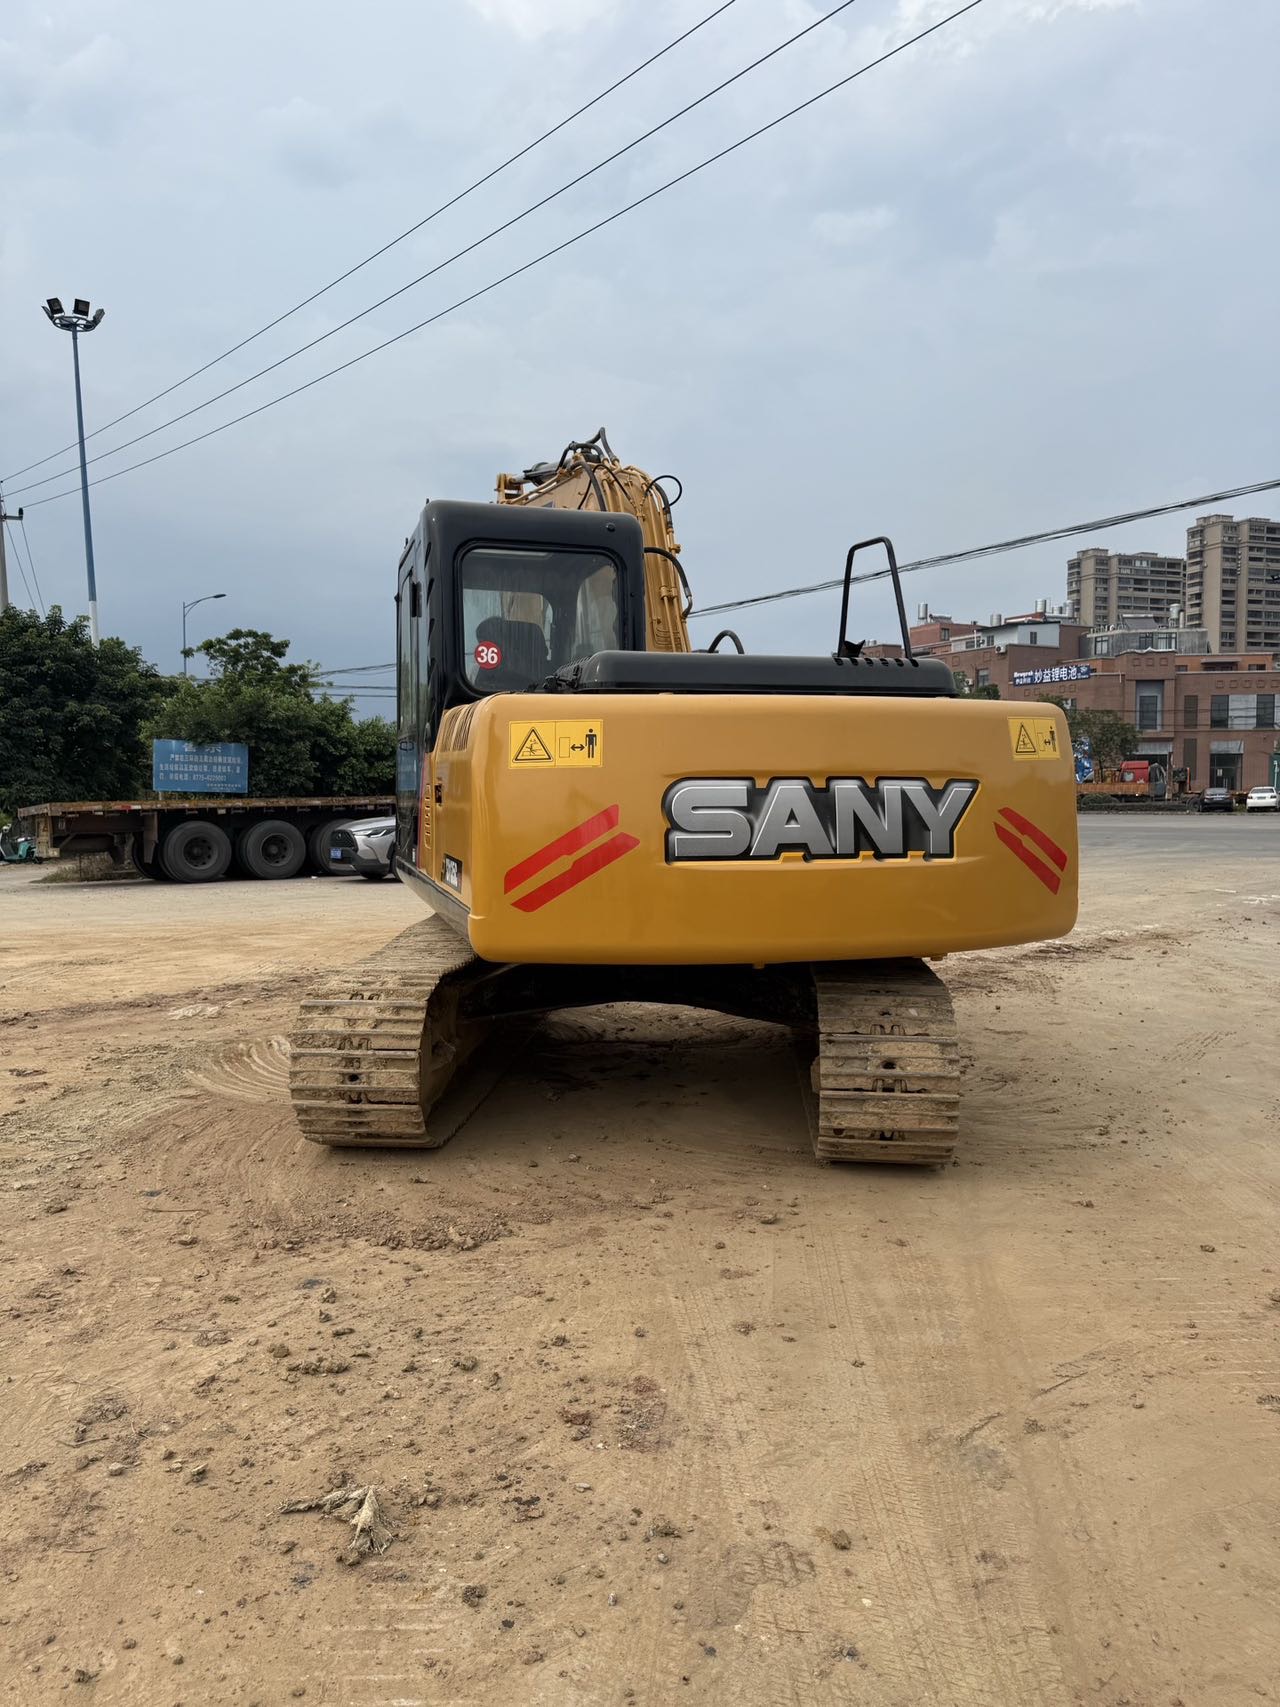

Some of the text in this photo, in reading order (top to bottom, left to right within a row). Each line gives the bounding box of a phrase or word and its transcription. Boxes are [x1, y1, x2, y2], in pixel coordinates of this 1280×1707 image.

[477, 645, 498, 664] 36
[1034, 666, 1077, 684] 妙益锂电池
[664, 779, 978, 862] SANY
